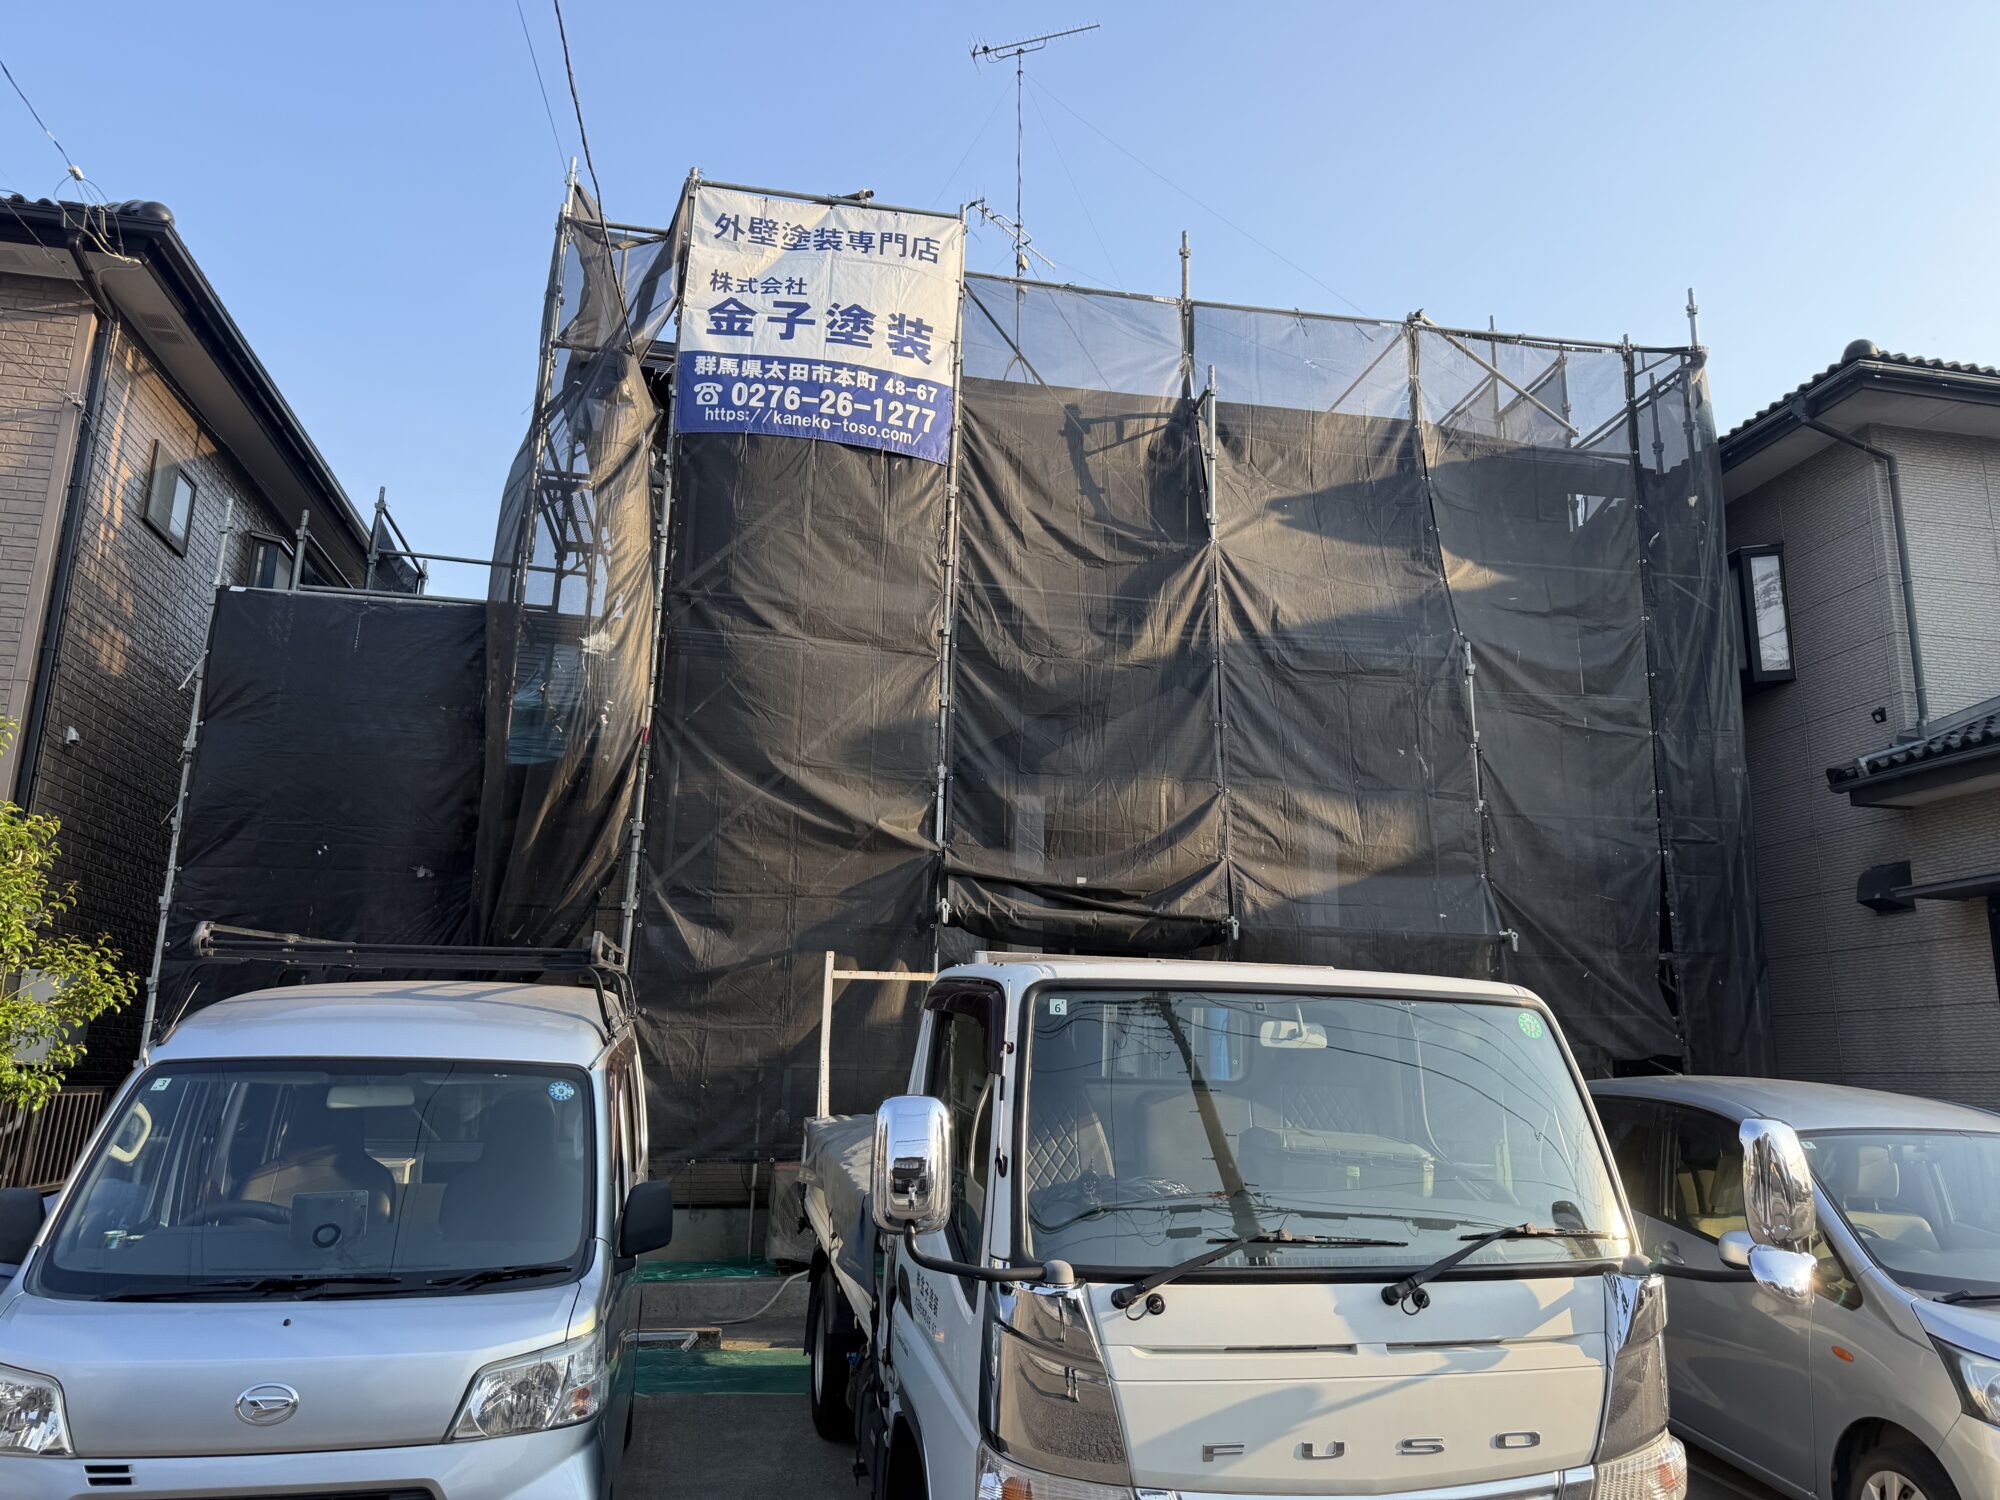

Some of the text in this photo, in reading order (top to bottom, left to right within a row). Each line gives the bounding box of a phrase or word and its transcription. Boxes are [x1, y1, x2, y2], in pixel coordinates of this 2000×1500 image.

[713, 212, 941, 264] 外壁塗装専門店
[709, 269, 807, 295] 株式会社
[706, 297, 933, 365] 金子塗装
[694, 355, 938, 403] 群馬県太田市本町 48-67
[704, 407, 922, 446] https://kaneko-toso.com/
[731, 381, 936, 434] 0276-26-1277
[1054, 1003, 1061, 1013] 6
[1202, 1430, 1541, 1463] FUSO
